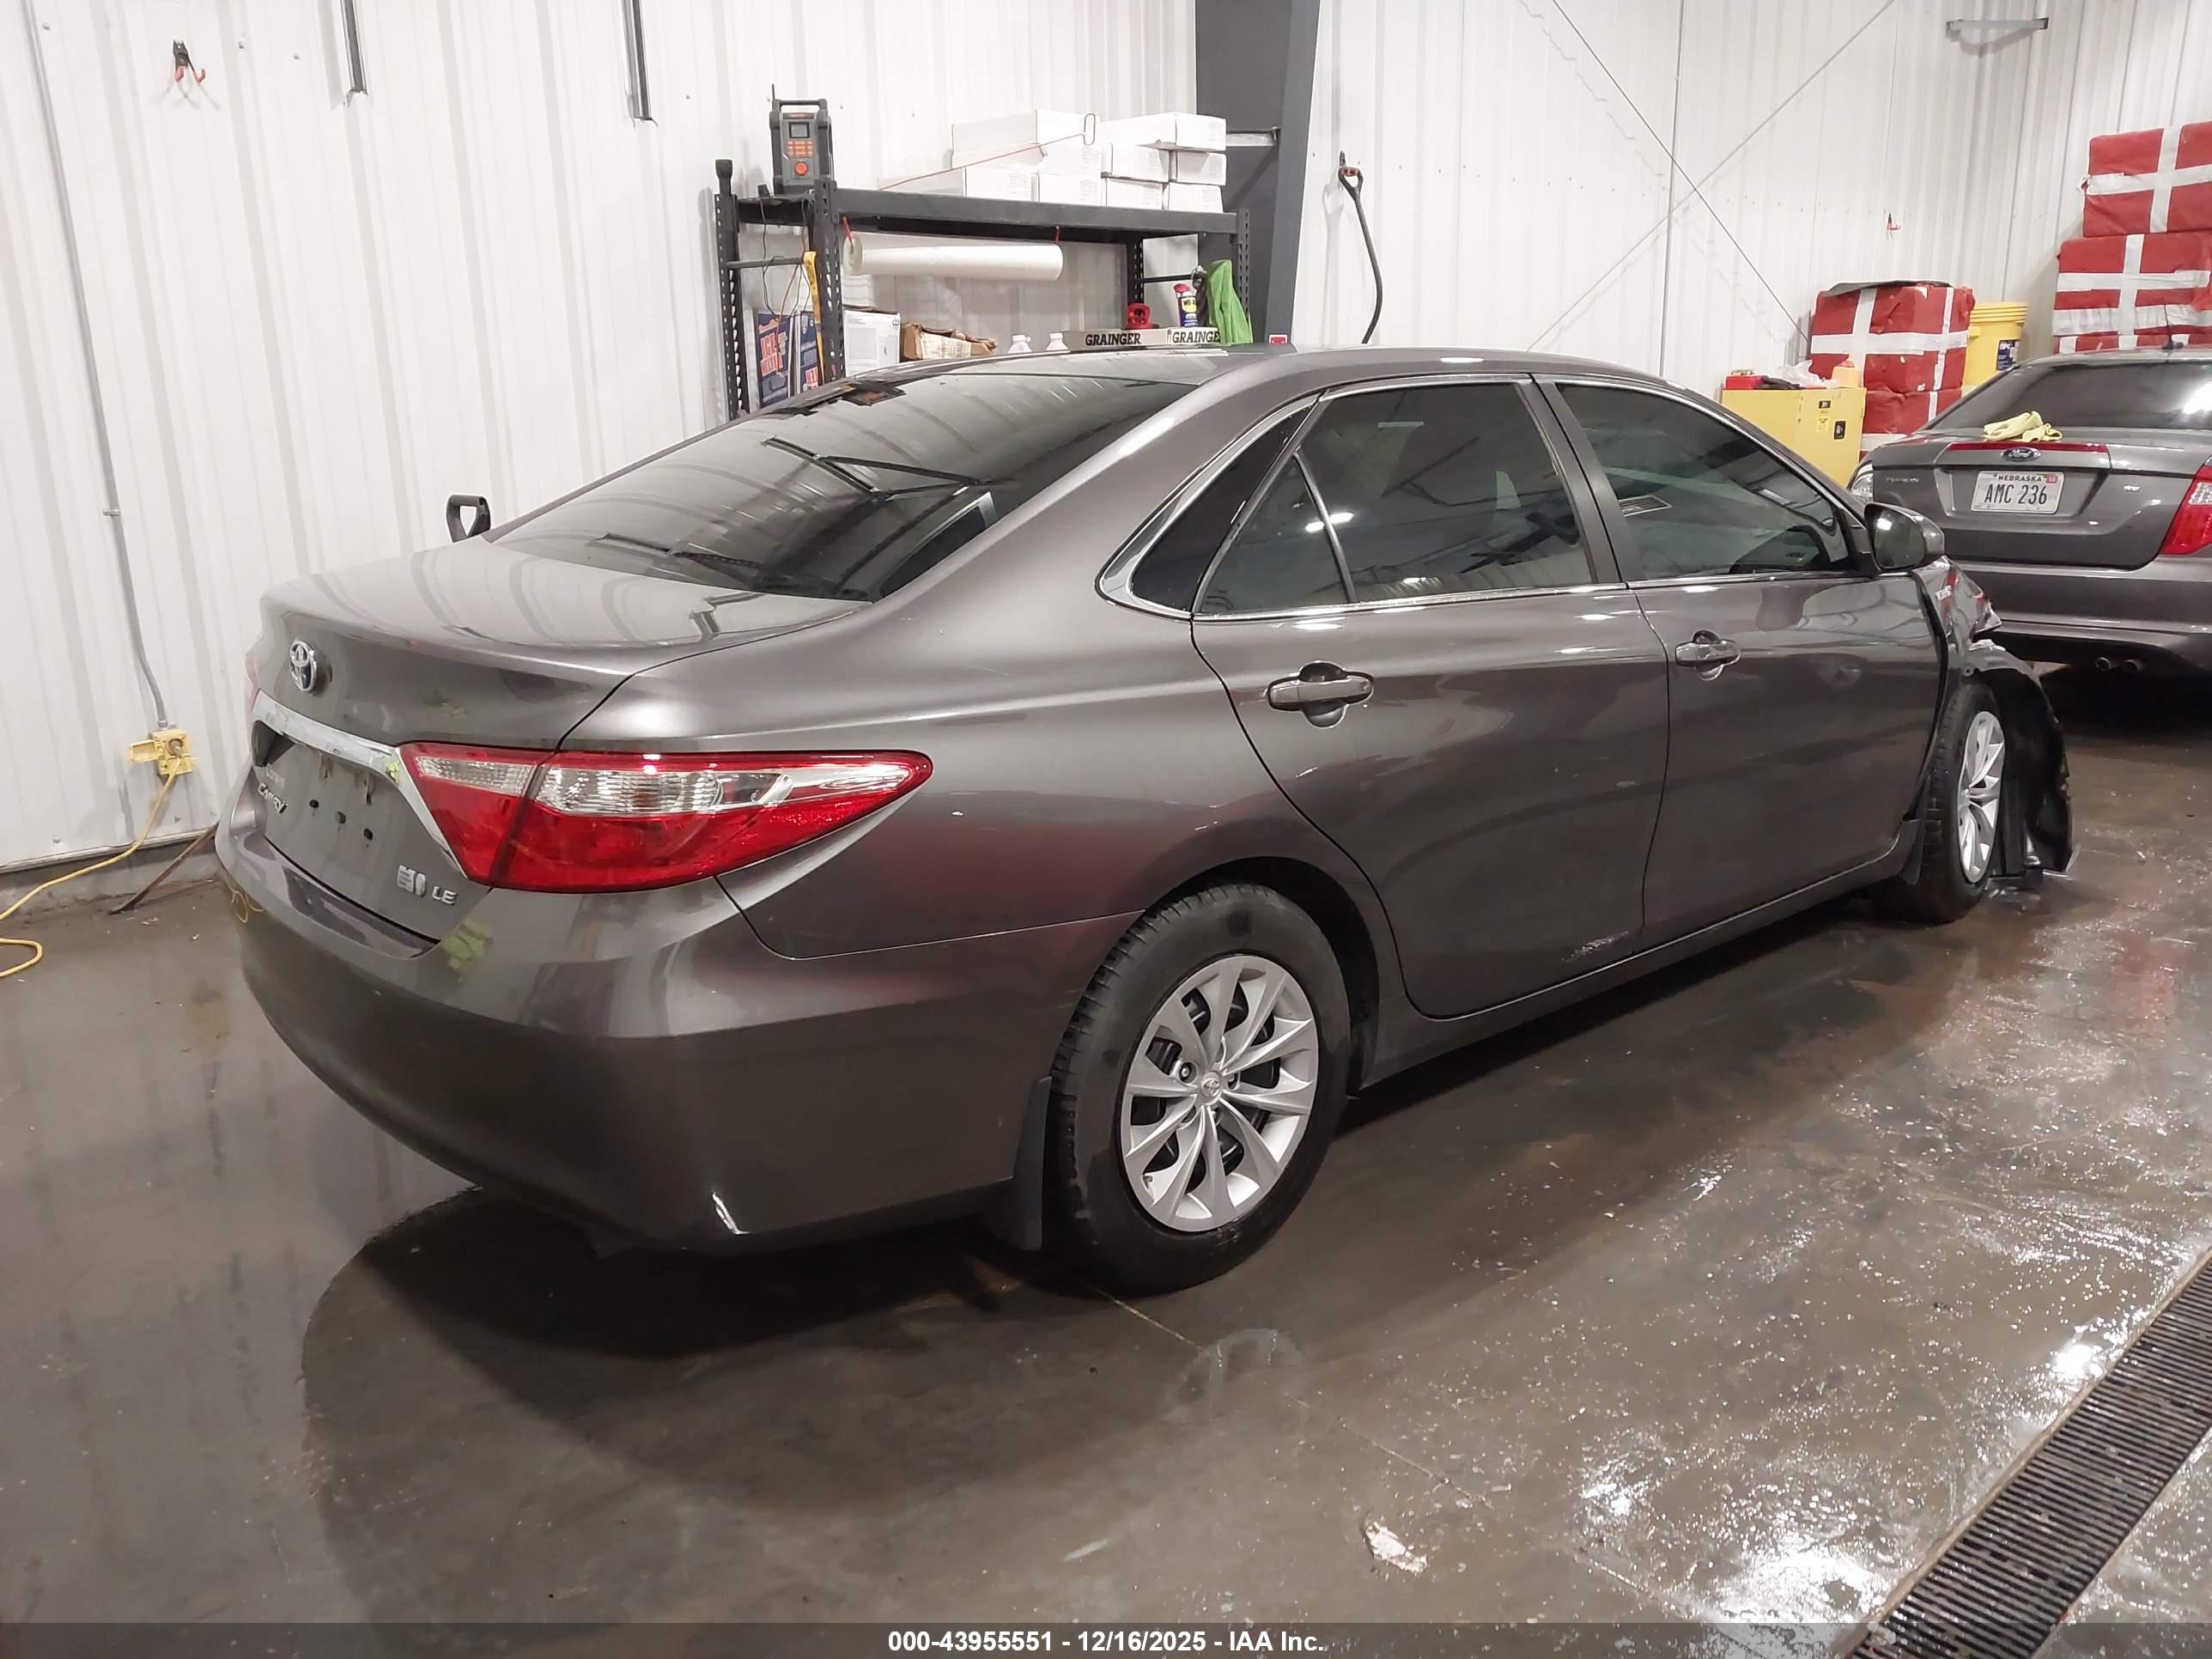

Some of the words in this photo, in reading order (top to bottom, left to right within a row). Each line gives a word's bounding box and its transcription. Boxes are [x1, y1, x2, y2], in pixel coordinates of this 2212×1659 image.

[1085, 332, 1141, 346] GRAINGER
[1172, 330, 1220, 343] GRAINGE
[2008, 447, 2033, 459] Ford
[1984, 483, 2014, 503] AMC
[2018, 484, 2047, 505] 236
[432, 885, 458, 905] LE
